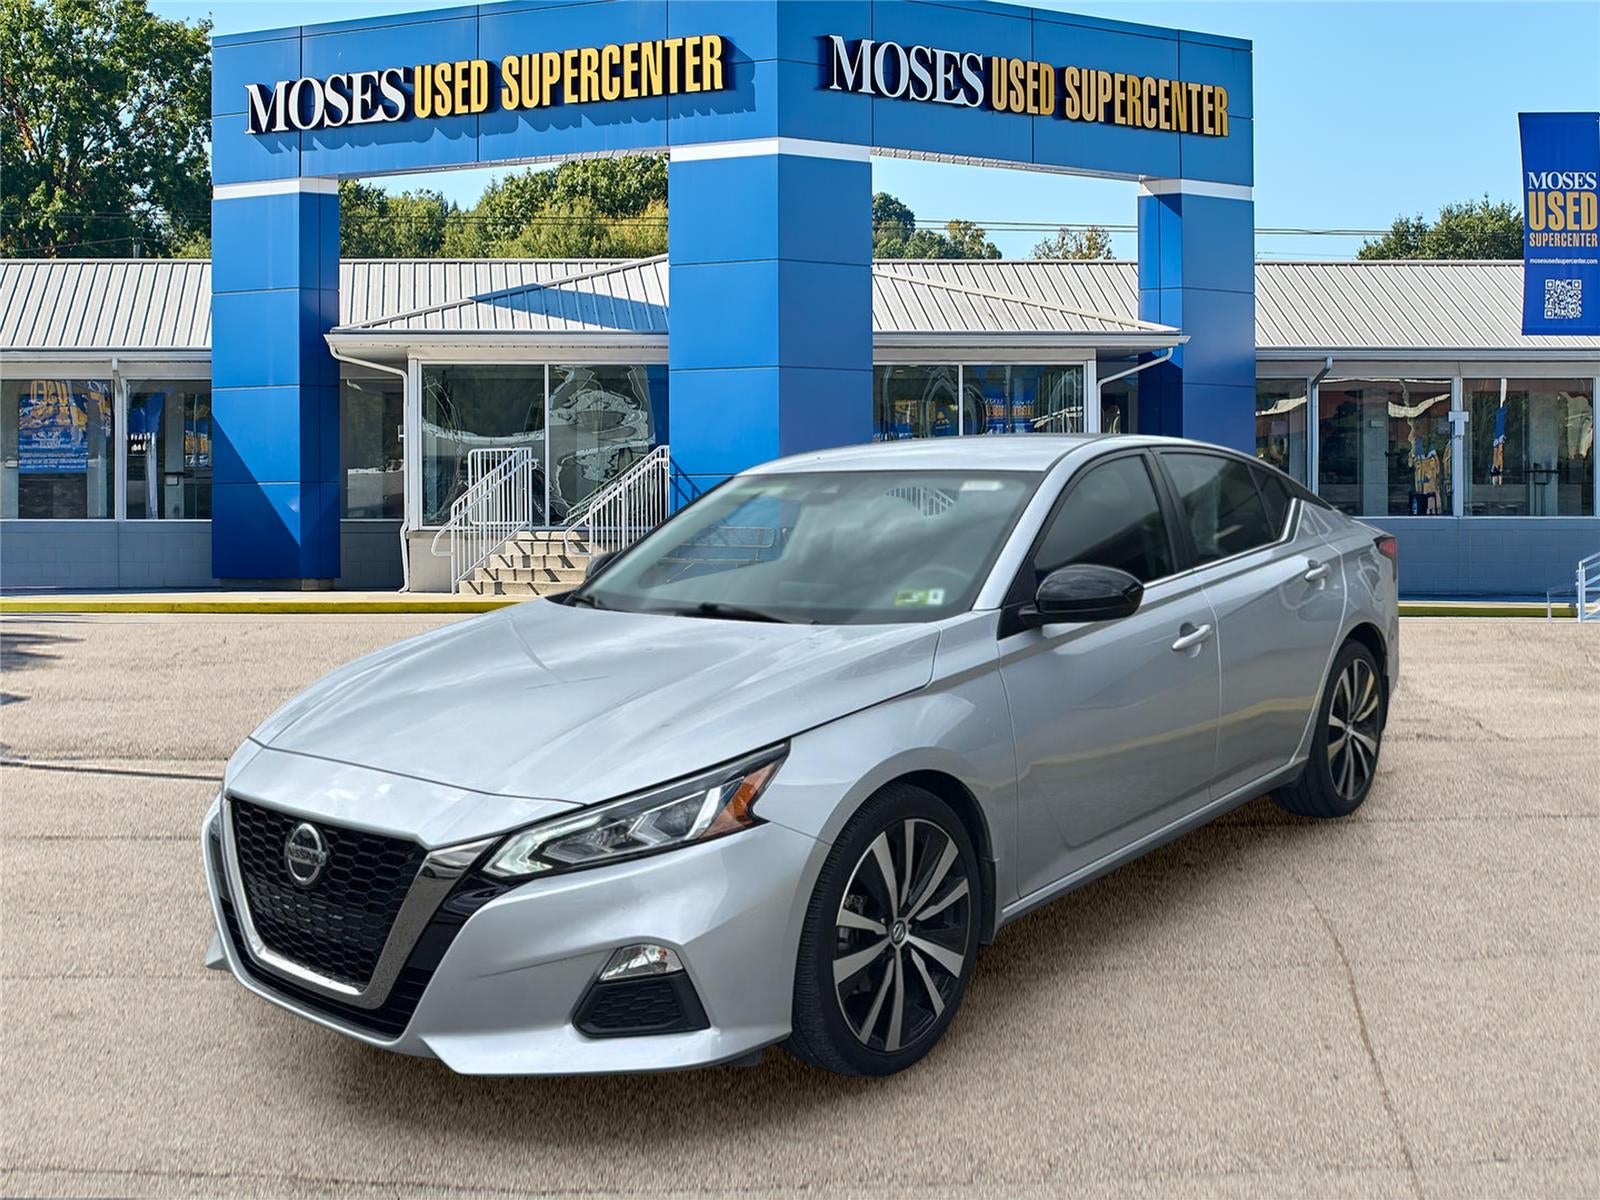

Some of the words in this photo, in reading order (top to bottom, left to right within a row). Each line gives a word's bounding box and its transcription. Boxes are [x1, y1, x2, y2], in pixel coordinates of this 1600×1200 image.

[245, 67, 408, 135] MOSES
[413, 59, 489, 119] USED
[501, 34, 724, 110] SUPERCENTER
[828, 34, 985, 108] MOSES
[991, 56, 1055, 116] USED
[1064, 66, 1229, 137] SUPERCENTER
[1527, 172, 1597, 190] MOSES
[1528, 191, 1598, 231] USED
[1529, 233, 1598, 248] SUPERCENTER
[288, 846, 323, 865] NISSAN
